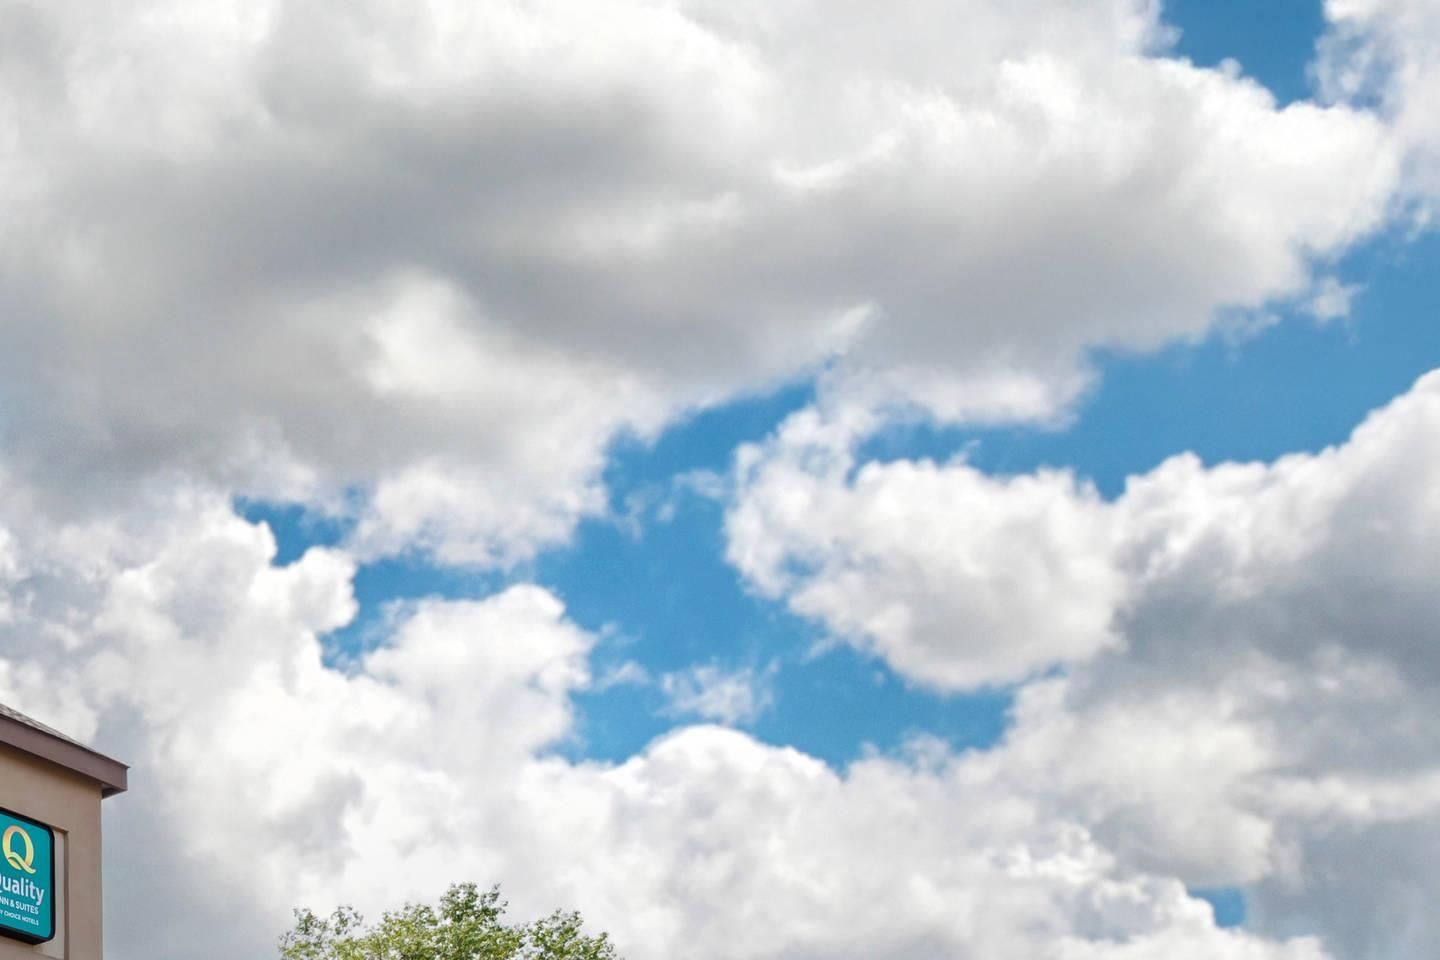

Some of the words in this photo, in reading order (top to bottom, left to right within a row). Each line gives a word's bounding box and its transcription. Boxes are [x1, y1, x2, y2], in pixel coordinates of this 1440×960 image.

[10, 899, 14, 908] &
[15, 900, 39, 915] SUITES
[4, 910, 21, 921] CHOICE
[22, 915, 39, 926] HOTELS
